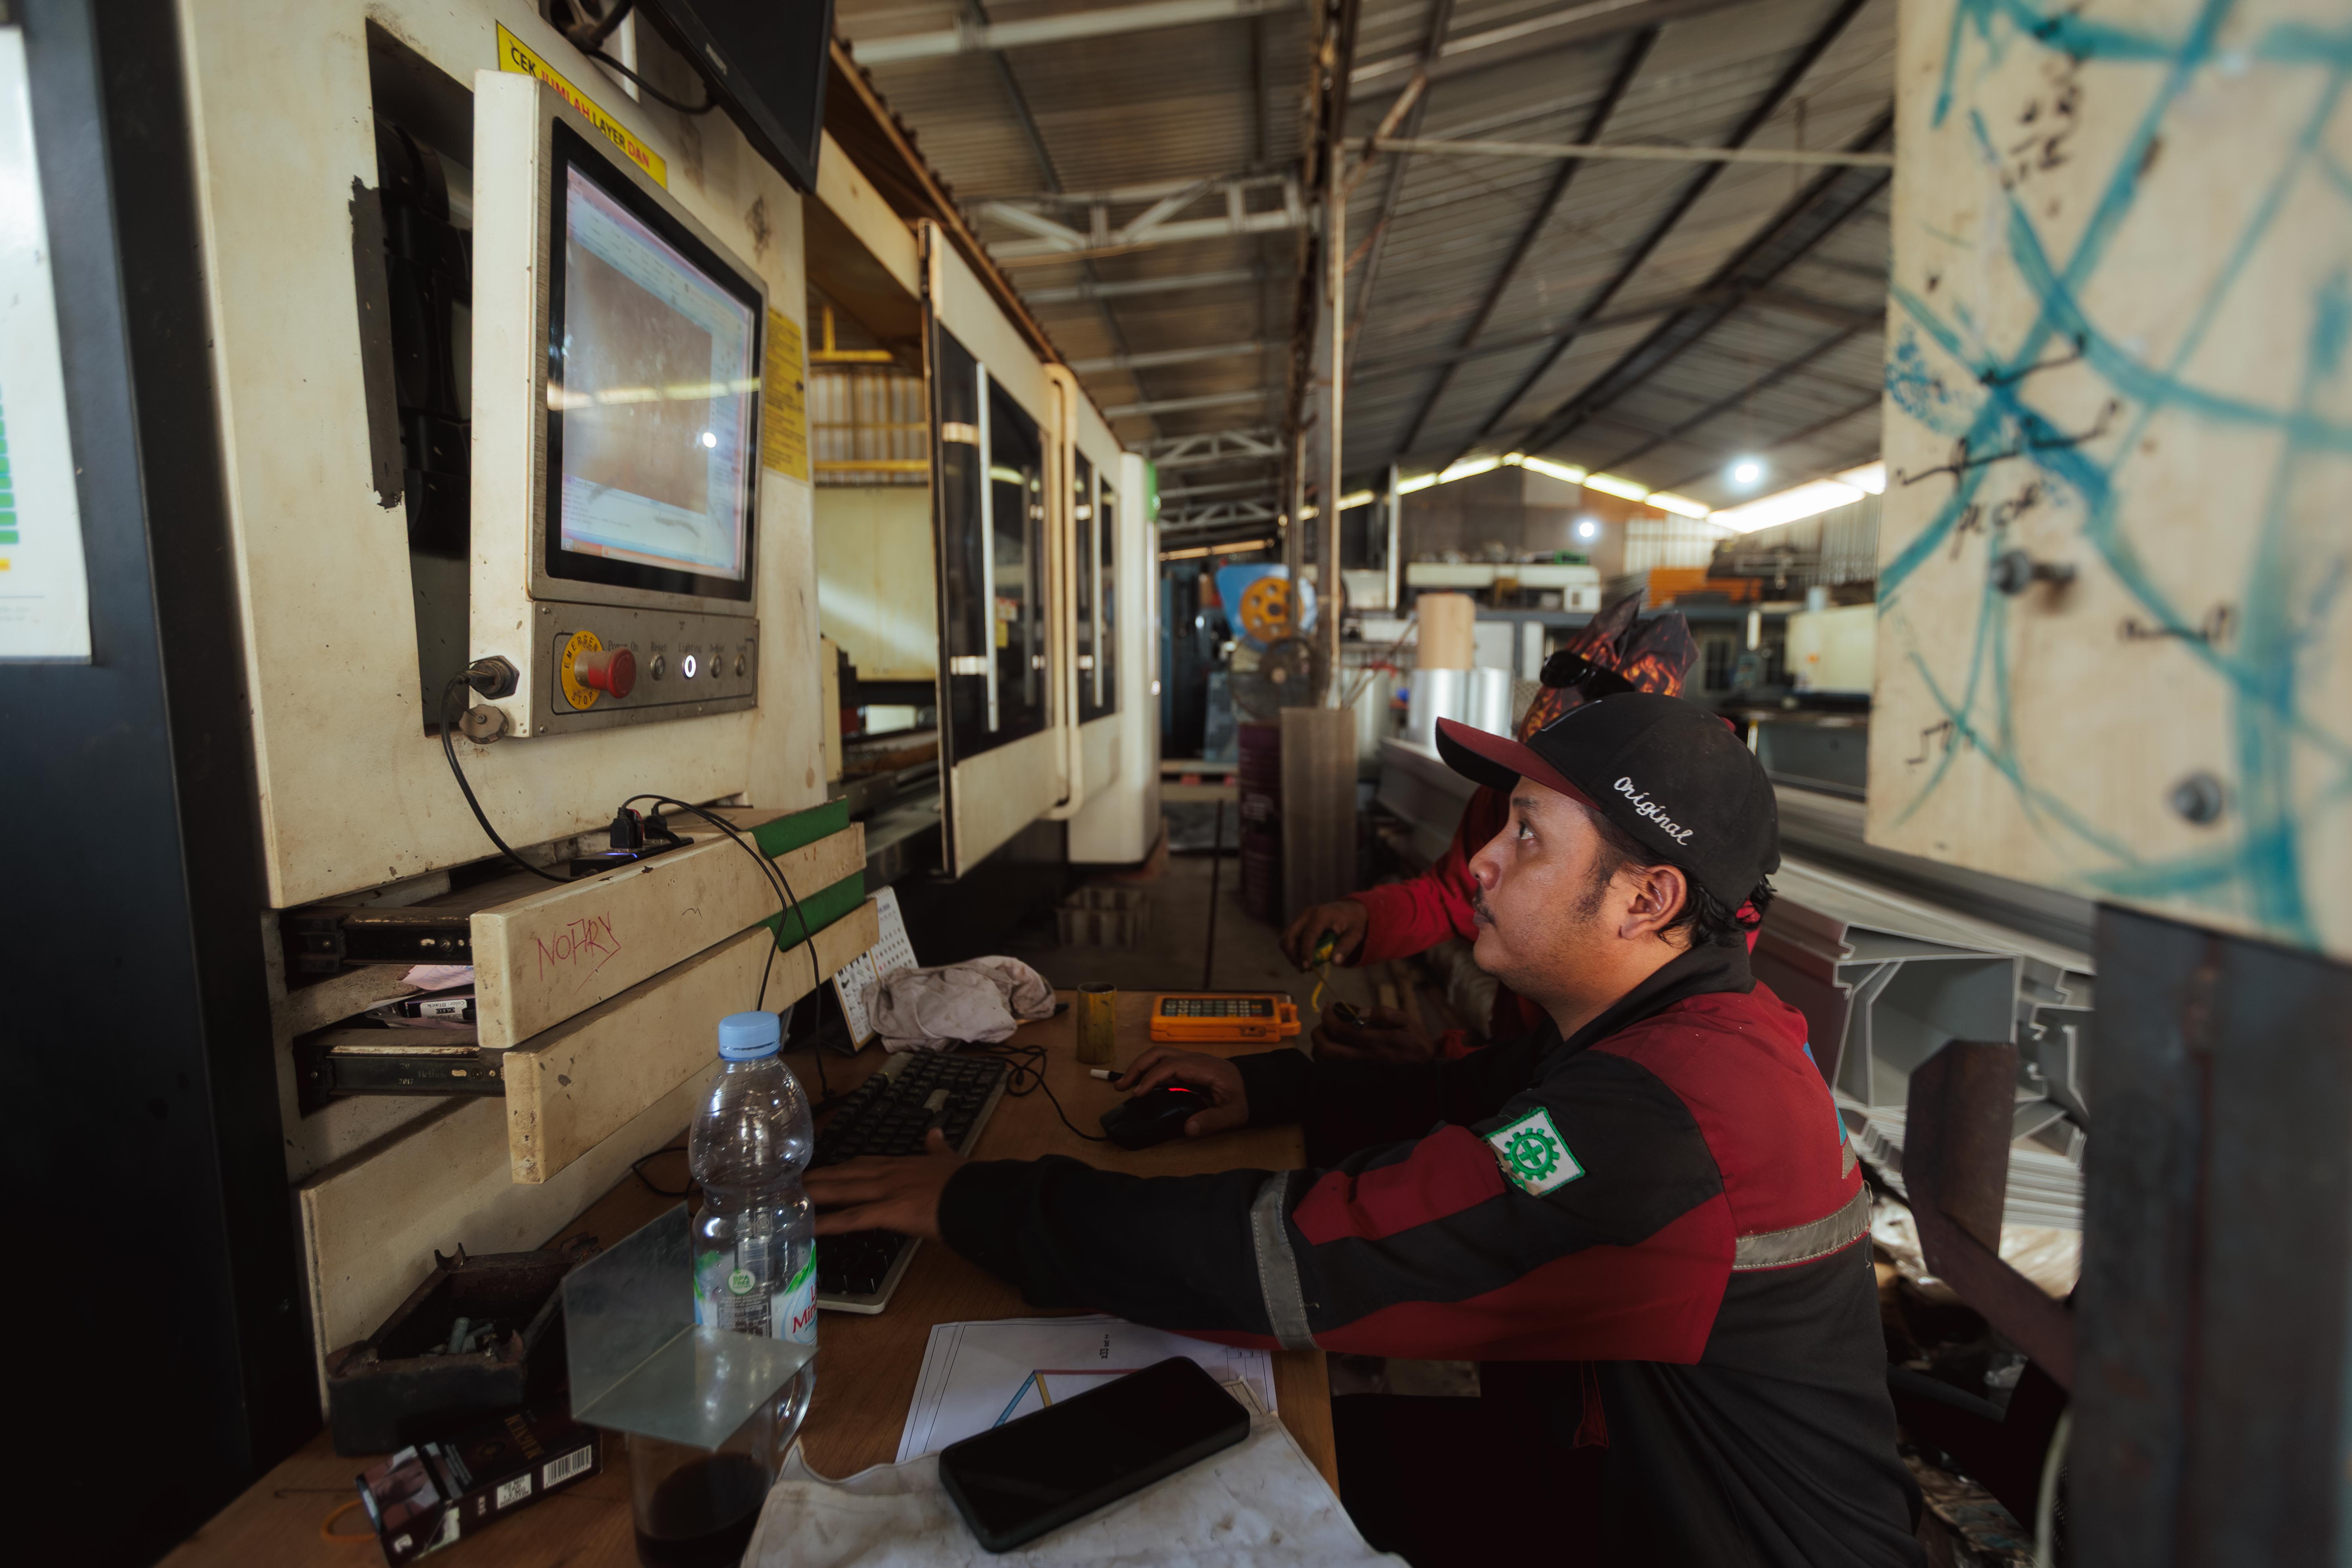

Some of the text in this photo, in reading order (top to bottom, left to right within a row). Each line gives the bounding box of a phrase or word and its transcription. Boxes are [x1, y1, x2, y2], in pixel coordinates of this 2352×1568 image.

[511, 47, 536, 77] CEK
[593, 112, 625, 149] LAYER
[627, 141, 650, 169] DAN
[564, 634, 599, 669] EMERGEN
[572, 691, 593, 705] STOP
[1614, 777, 1694, 845] Original
